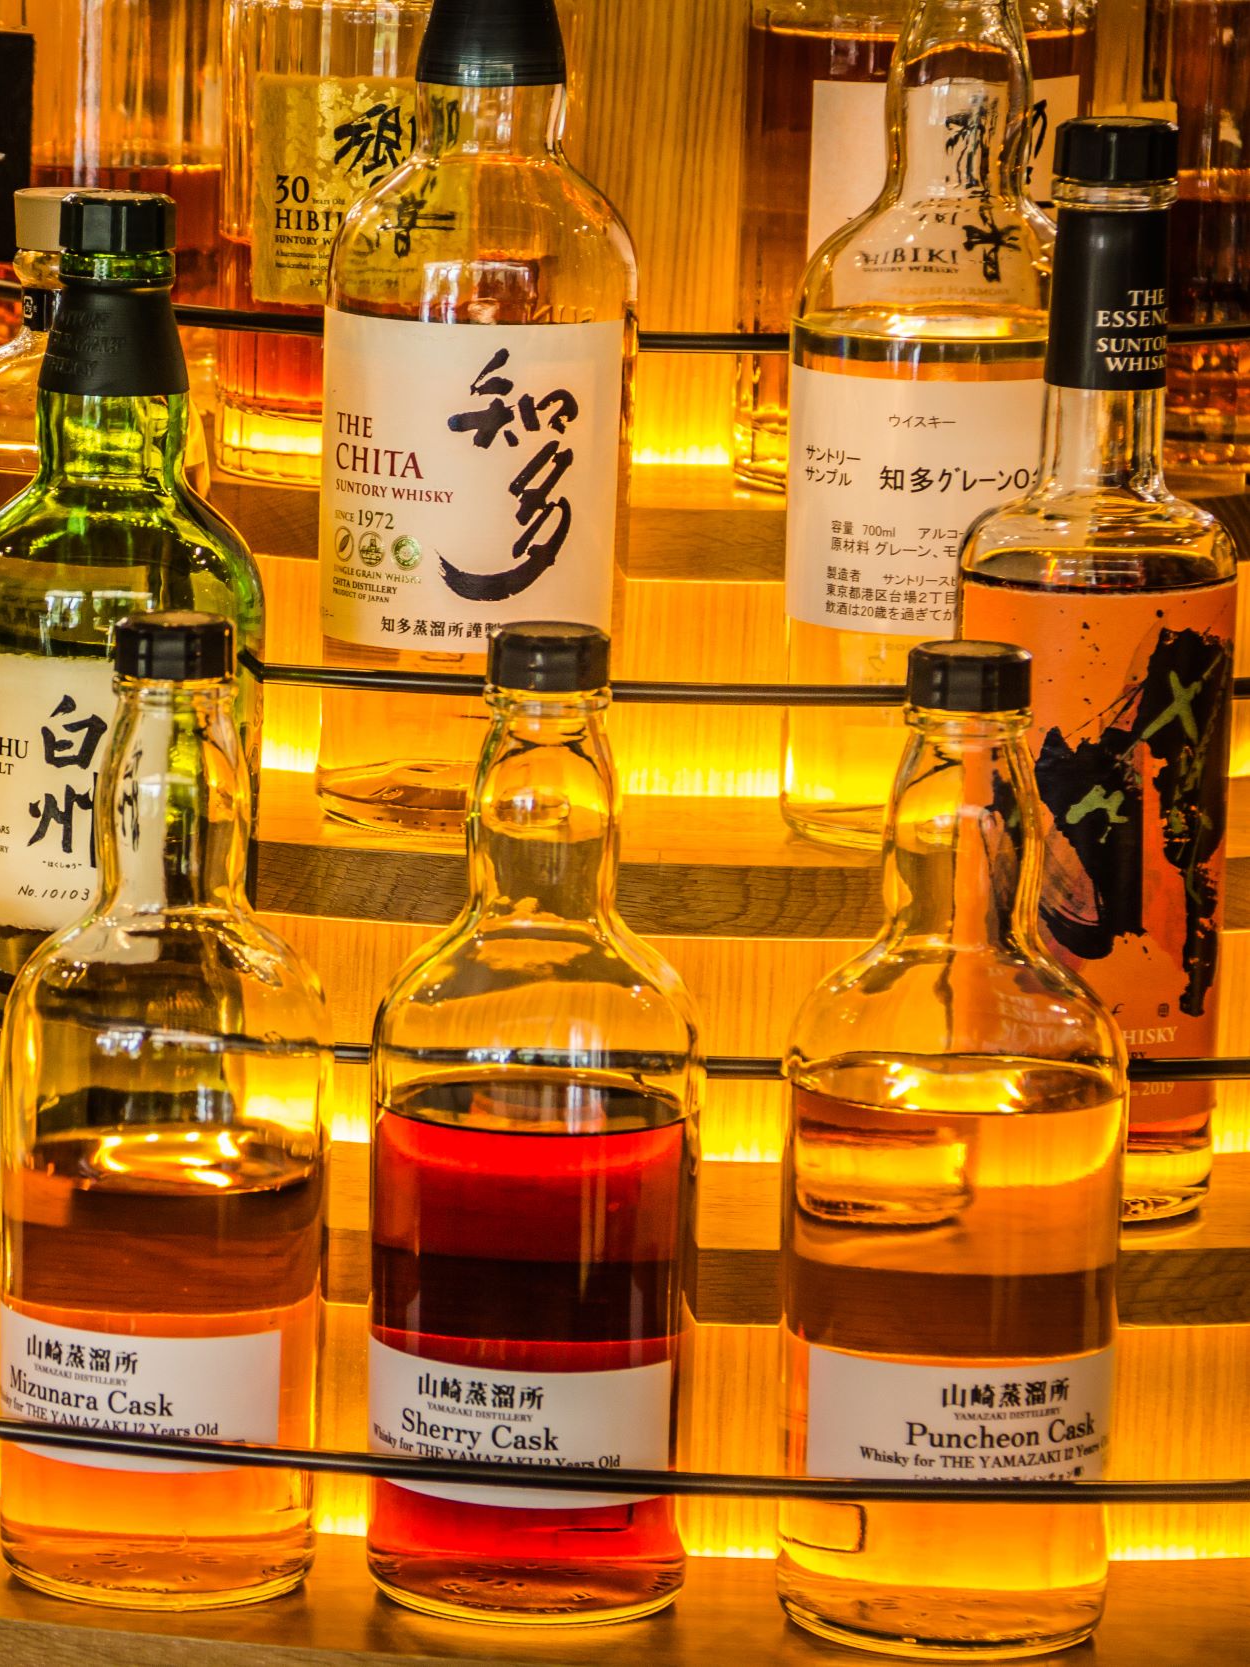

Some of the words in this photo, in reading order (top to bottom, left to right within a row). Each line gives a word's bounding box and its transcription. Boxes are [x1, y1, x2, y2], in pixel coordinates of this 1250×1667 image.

[275, 175, 309, 204] 30
[275, 235, 318, 246] SUNTORY
[1127, 288, 1165, 306] THE
[337, 411, 373, 438] THE
[888, 414, 956, 429] ウイスキー
[336, 443, 424, 480] CHITA
[806, 444, 861, 466] サントリー
[434, 347, 579, 602] 知多
[806, 466, 853, 487] サンプル
[336, 478, 387, 498] SUNTORY
[392, 488, 454, 504] WHISKY
[335, 510, 355, 522] SINCE
[358, 509, 395, 530] 1972
[831, 520, 854, 536] 容量
[862, 524, 896, 538] 700ml
[831, 536, 870, 556] 原材料
[333, 576, 351, 588] CHITA
[352, 581, 397, 594] DISTILLERY
[356, 567, 382, 580] GRAIN
[385, 572, 422, 584] WHISKY
[827, 565, 862, 583] 製造者
[333, 587, 356, 599] PRODUCT
[367, 595, 390, 603] JAPAN
[27, 694, 108, 868] 白州
[1121, 1025, 1178, 1045] HISKY
[1141, 1081, 1175, 1096] 2019
[26, 1333, 139, 1375] 山崎蒸溜所
[34, 1363, 73, 1381] YAMAZAKI
[74, 1371, 129, 1387] DISTILLERY
[9, 1365, 99, 1411] Mizunara
[107, 1389, 174, 1417] Cask
[418, 1372, 544, 1411] 山崎蒸溜所
[941, 1377, 1070, 1409] 山崎蒸溜所
[25, 1402, 48, 1421] THE
[50, 1410, 129, 1434] YAMAZAKI
[150, 1423, 190, 1437] Years
[194, 1422, 219, 1437] Old
[427, 1402, 473, 1418] YAMAZAKI
[475, 1410, 534, 1422] DISTILLERY
[953, 1411, 1008, 1422] YAMAZAKI
[1009, 1406, 1062, 1420] DISTILLERY
[401, 1407, 482, 1451] Sherry
[491, 1423, 559, 1452] Cask
[905, 1420, 1040, 1449] Puncheon
[1047, 1411, 1096, 1444] Cask
[373, 1422, 398, 1449] Whisky
[399, 1437, 414, 1453] for
[416, 1441, 444, 1460] THE
[598, 1454, 622, 1469] Old
[859, 1445, 910, 1468] Whisky
[914, 1453, 936, 1468] for
[939, 1454, 975, 1469] THE
[979, 1449, 1061, 1469] YAMAZAKI
[1064, 1447, 1075, 1461] 12
[1076, 1442, 1101, 1459] Years
